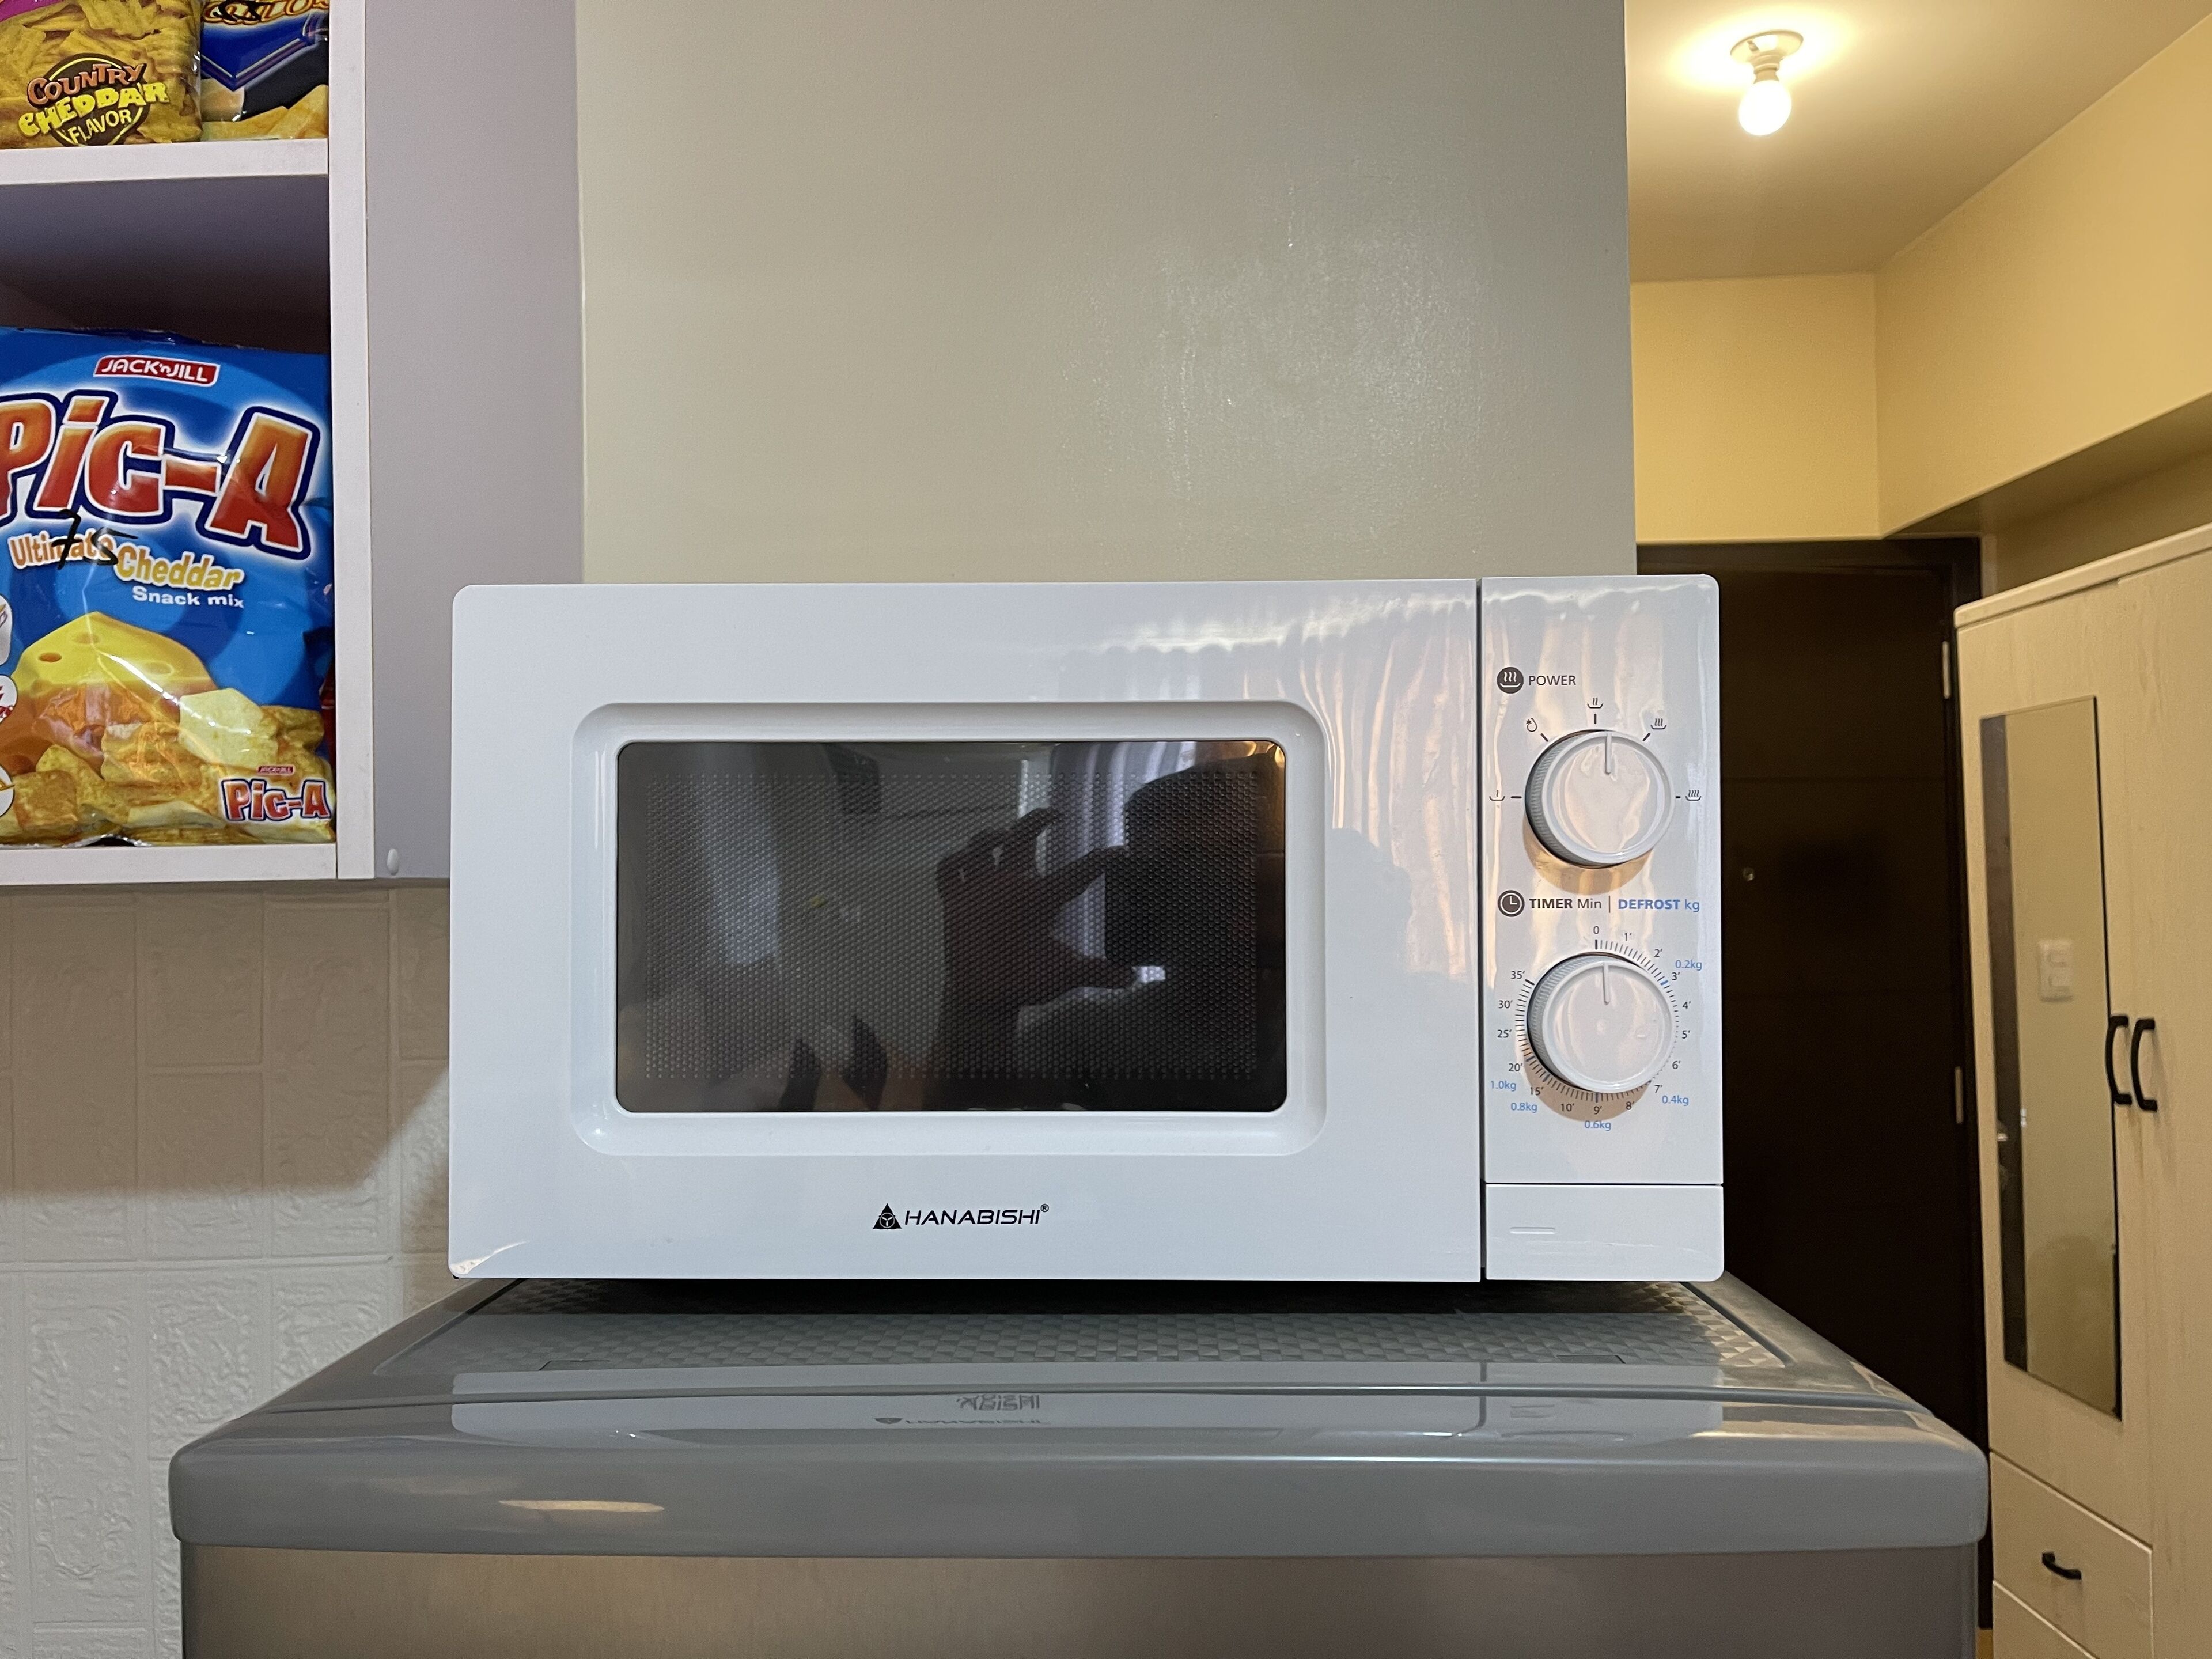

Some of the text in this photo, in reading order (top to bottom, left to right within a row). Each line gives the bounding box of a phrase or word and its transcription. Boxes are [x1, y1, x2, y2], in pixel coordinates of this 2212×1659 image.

[27, 63, 147, 106] COUNTRY
[18, 81, 171, 137] CHEDDAR
[67, 108, 132, 144] FLAVOR
[116, 543, 243, 589] Cheddar
[132, 585, 244, 609] Snack mix
[1529, 675, 1576, 685] POWER
[222, 779, 331, 821] Pic-A
[1529, 899, 1699, 912] TIMER Min DEFROST kg
[1593, 926, 1599, 934] 0
[1675, 960, 1702, 971] 0.2kg
[1491, 1081, 1516, 1092] 1.0kg
[1662, 1095, 1689, 1106] 0.4kg
[1511, 1102, 1537, 1113] 0.8kg
[1584, 1120, 1611, 1131] 0.6kg
